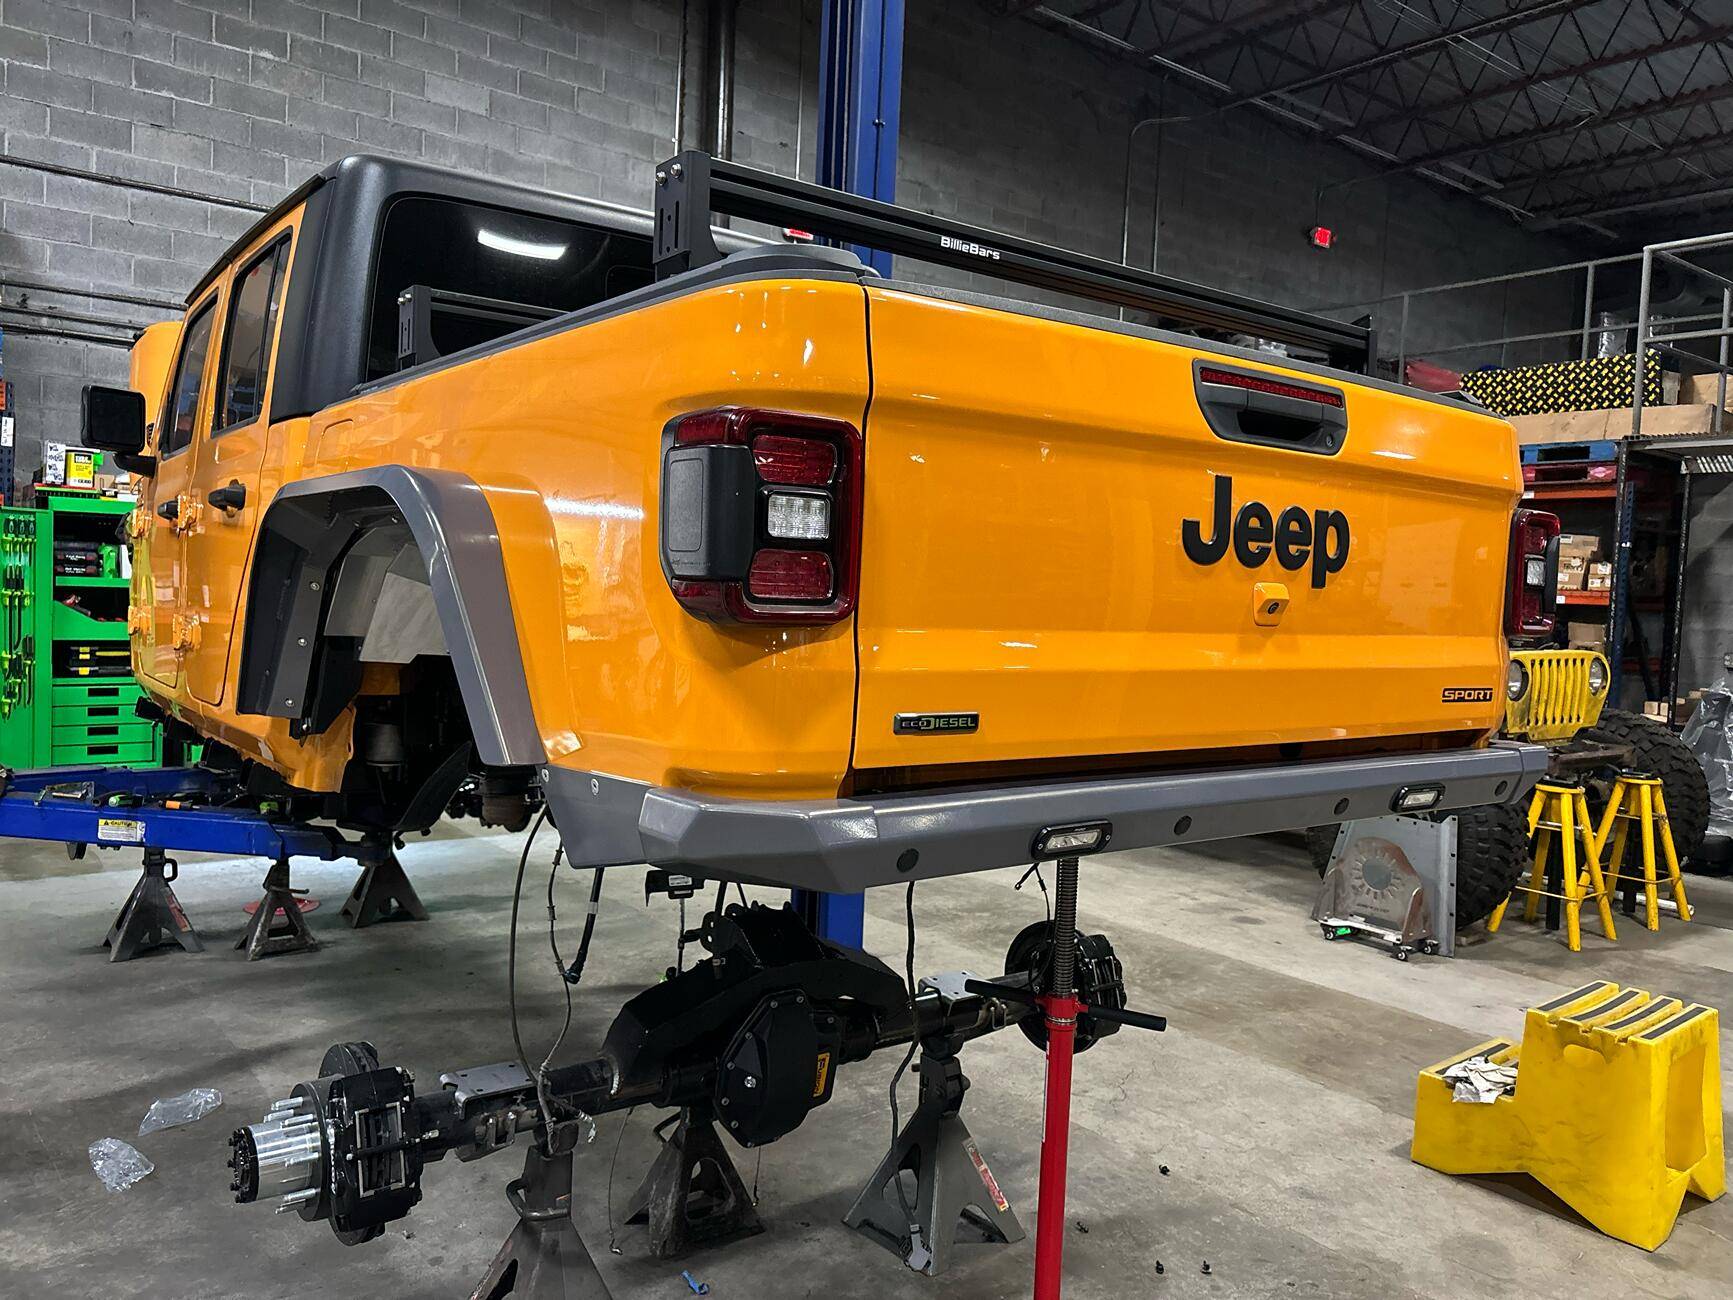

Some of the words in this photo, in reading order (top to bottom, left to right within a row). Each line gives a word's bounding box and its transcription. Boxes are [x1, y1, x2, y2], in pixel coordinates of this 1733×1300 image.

[940, 236, 1000, 260] BillieBars
[1182, 474, 1350, 589] Jeep
[1441, 690, 1494, 700] SPORT
